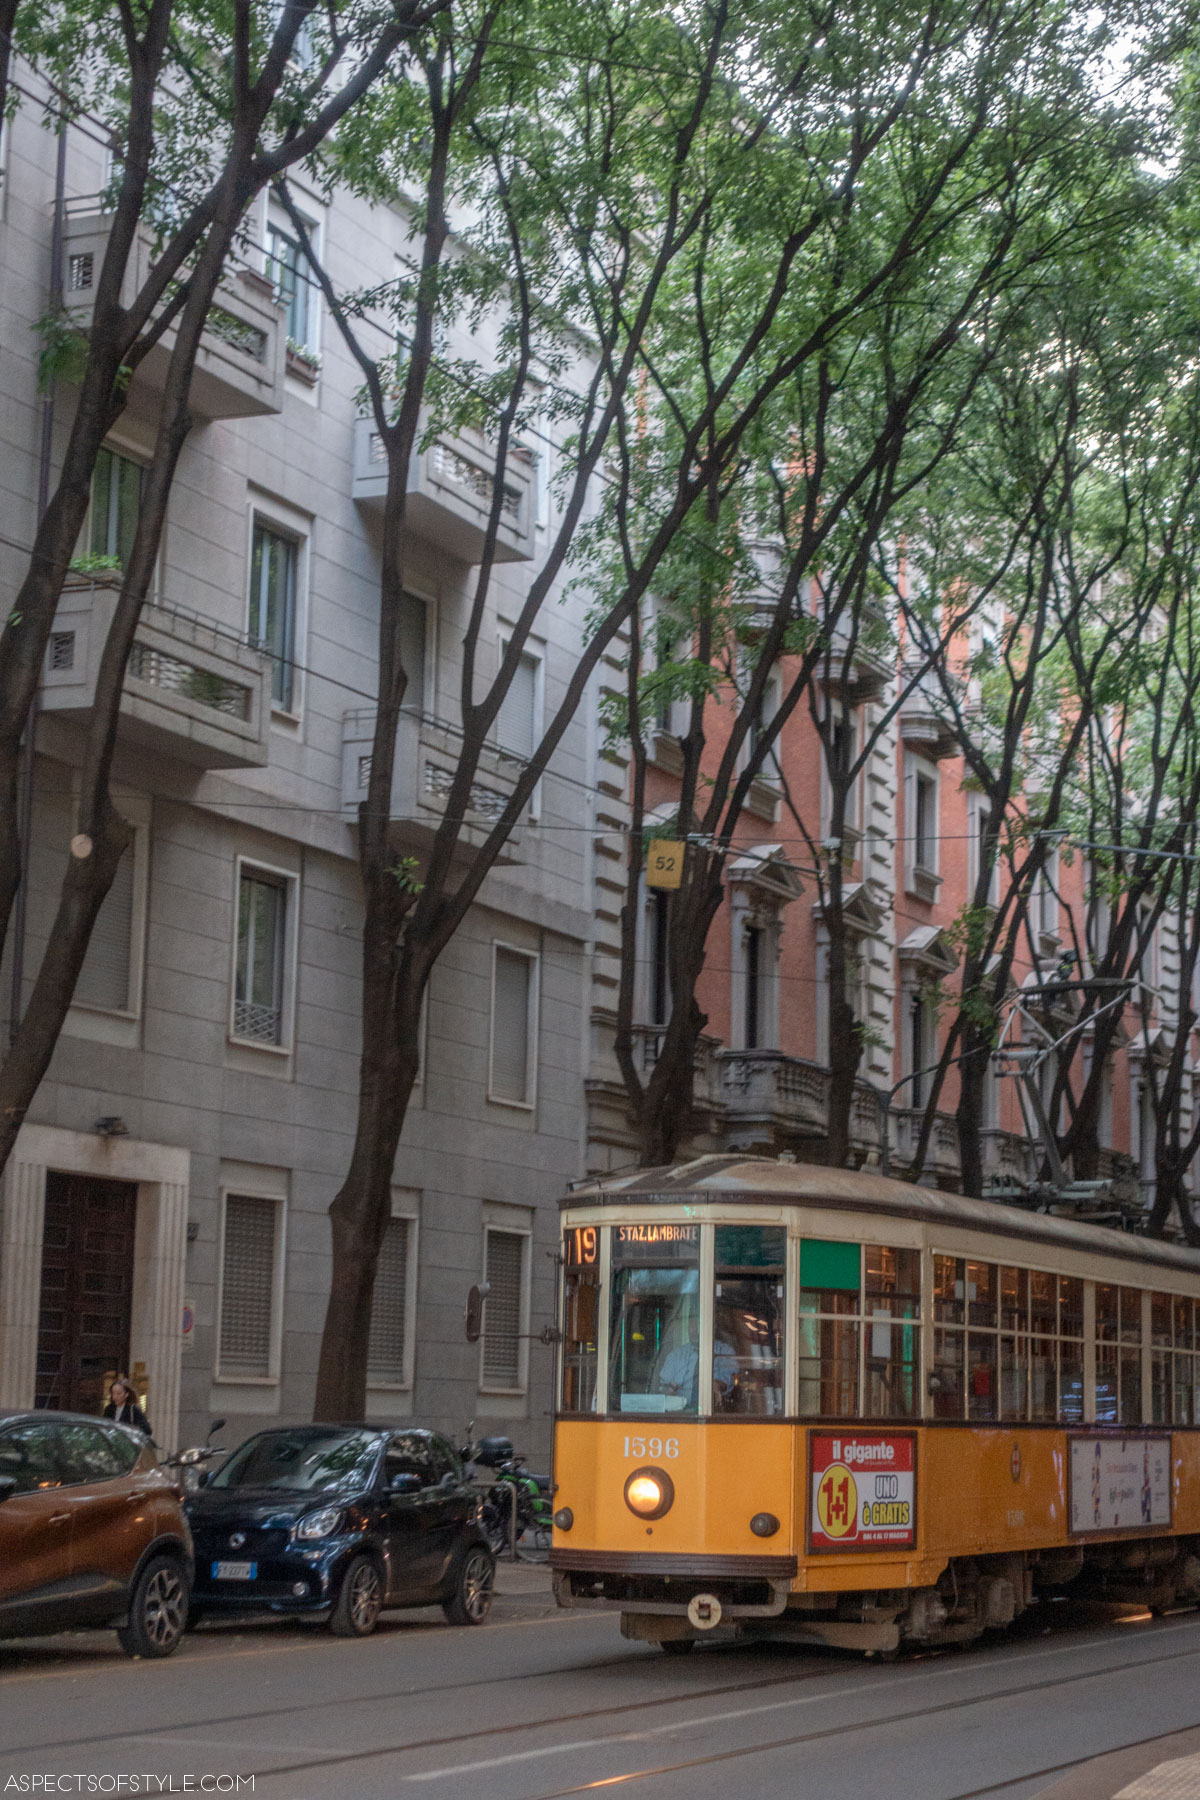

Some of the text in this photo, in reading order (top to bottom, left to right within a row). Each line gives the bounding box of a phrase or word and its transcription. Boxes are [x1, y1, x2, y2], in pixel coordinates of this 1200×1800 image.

[655, 856, 676, 872] 52
[619, 1225, 697, 1241] STAZ.LAMBRATE
[575, 1227, 598, 1264] 19
[624, 1436, 680, 1459] 1596
[832, 1440, 841, 1460] il
[844, 1441, 895, 1464] gigante
[875, 1475, 898, 1499] UNO
[863, 1501, 910, 1526] è GRATIS
